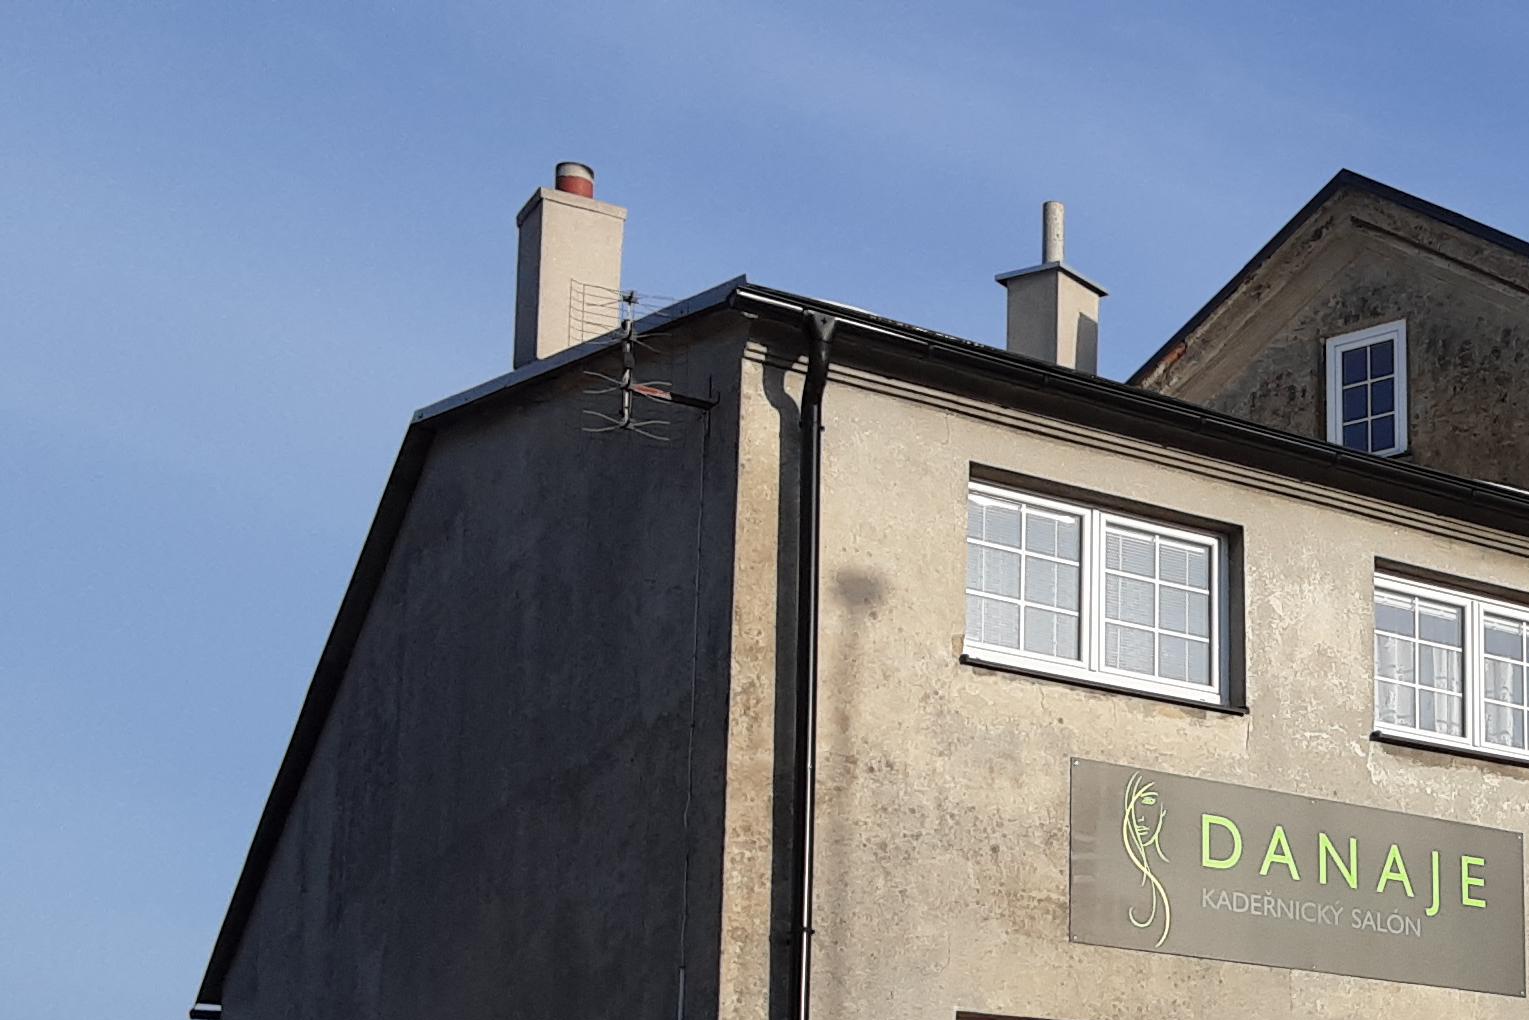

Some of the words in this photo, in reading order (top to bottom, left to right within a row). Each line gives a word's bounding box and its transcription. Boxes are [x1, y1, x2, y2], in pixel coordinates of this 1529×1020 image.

[1202, 814, 1486, 916] DANAJE
[1202, 887, 1344, 926] KADEŘNICKÝ
[1351, 907, 1422, 937] SALÓN
